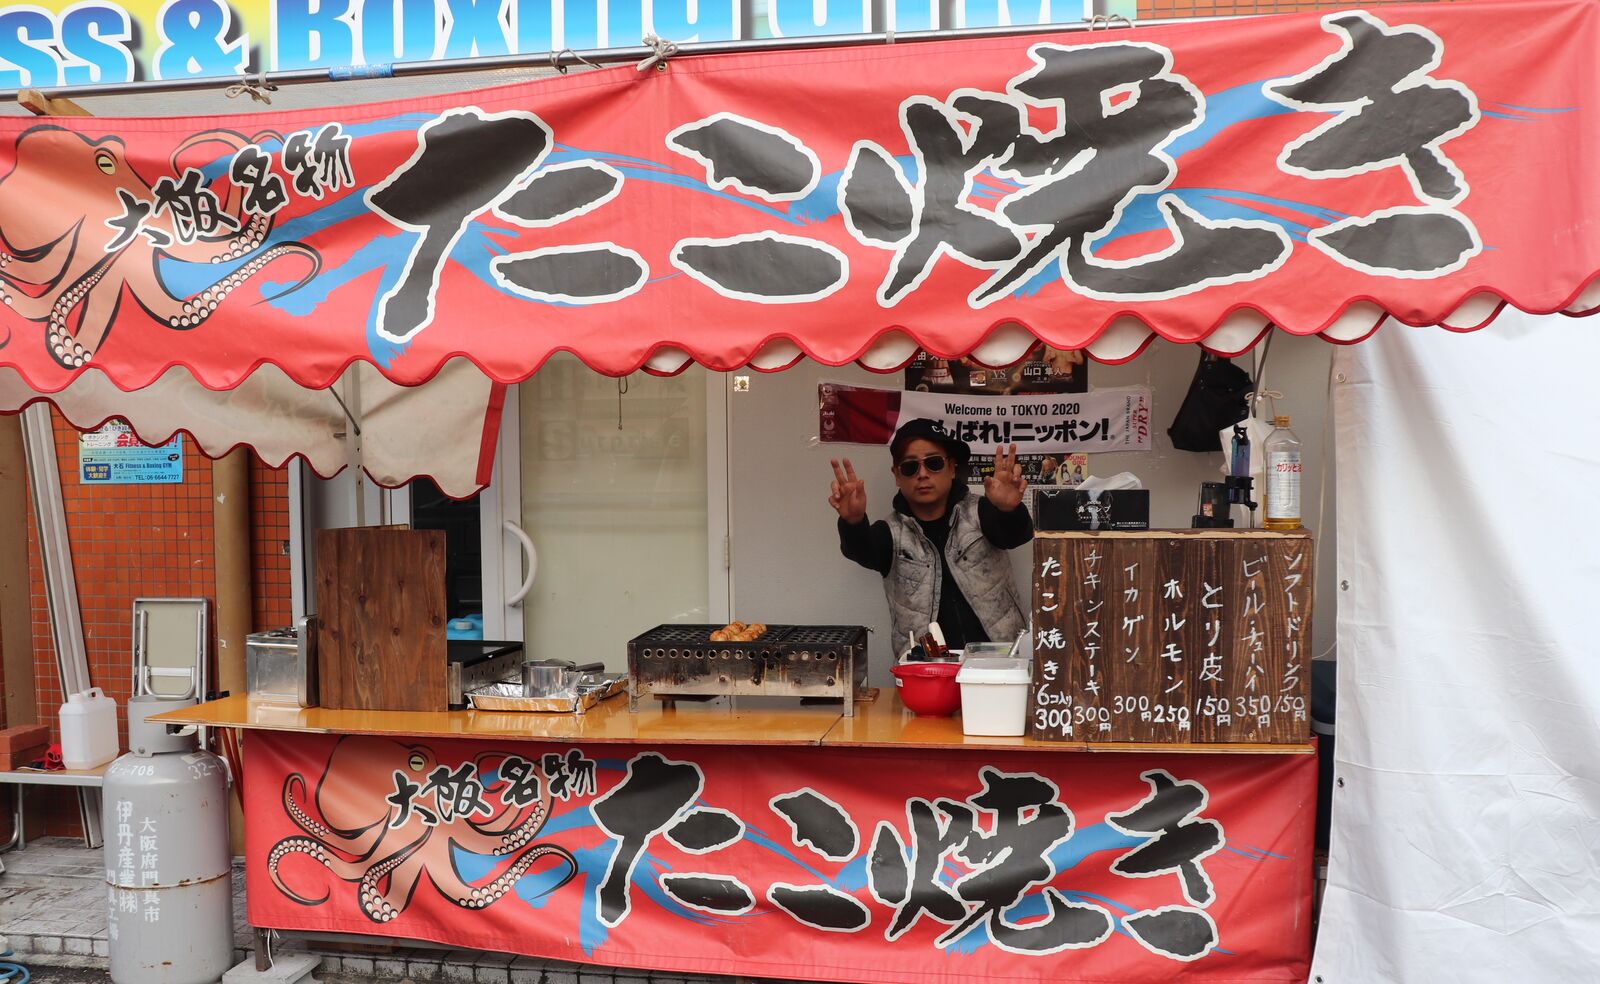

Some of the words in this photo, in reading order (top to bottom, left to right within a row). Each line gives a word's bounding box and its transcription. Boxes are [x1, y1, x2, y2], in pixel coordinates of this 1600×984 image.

[103, 122, 355, 252] 大阪名物
[363, 9, 1482, 344] たこ焼き
[944, 403, 992, 416] Welcome
[996, 405, 1007, 416] to
[1010, 404, 1048, 416] TOKYO
[1051, 402, 1080, 416] 2020
[1035, 556, 1066, 681] たこ焼き
[1083, 549, 1104, 696] チキンステーキ
[1161, 578, 1186, 693] ホルモン
[1199, 582, 1224, 682] とり皮
[1280, 554, 1303, 692] ソフトドリンク
[1035, 708, 1073, 737] 300円
[1074, 705, 1112, 732] 300円
[1113, 695, 1152, 722] 300円
[1153, 704, 1191, 731] 250円
[1196, 695, 1231, 727] 150円
[1235, 695, 1271, 728] 350円
[1273, 695, 1307, 721] 150円
[386, 748, 597, 828] 大阪名物
[139, 816, 161, 923] 大阪府門真市
[590, 751, 1226, 962] たこ焼き
